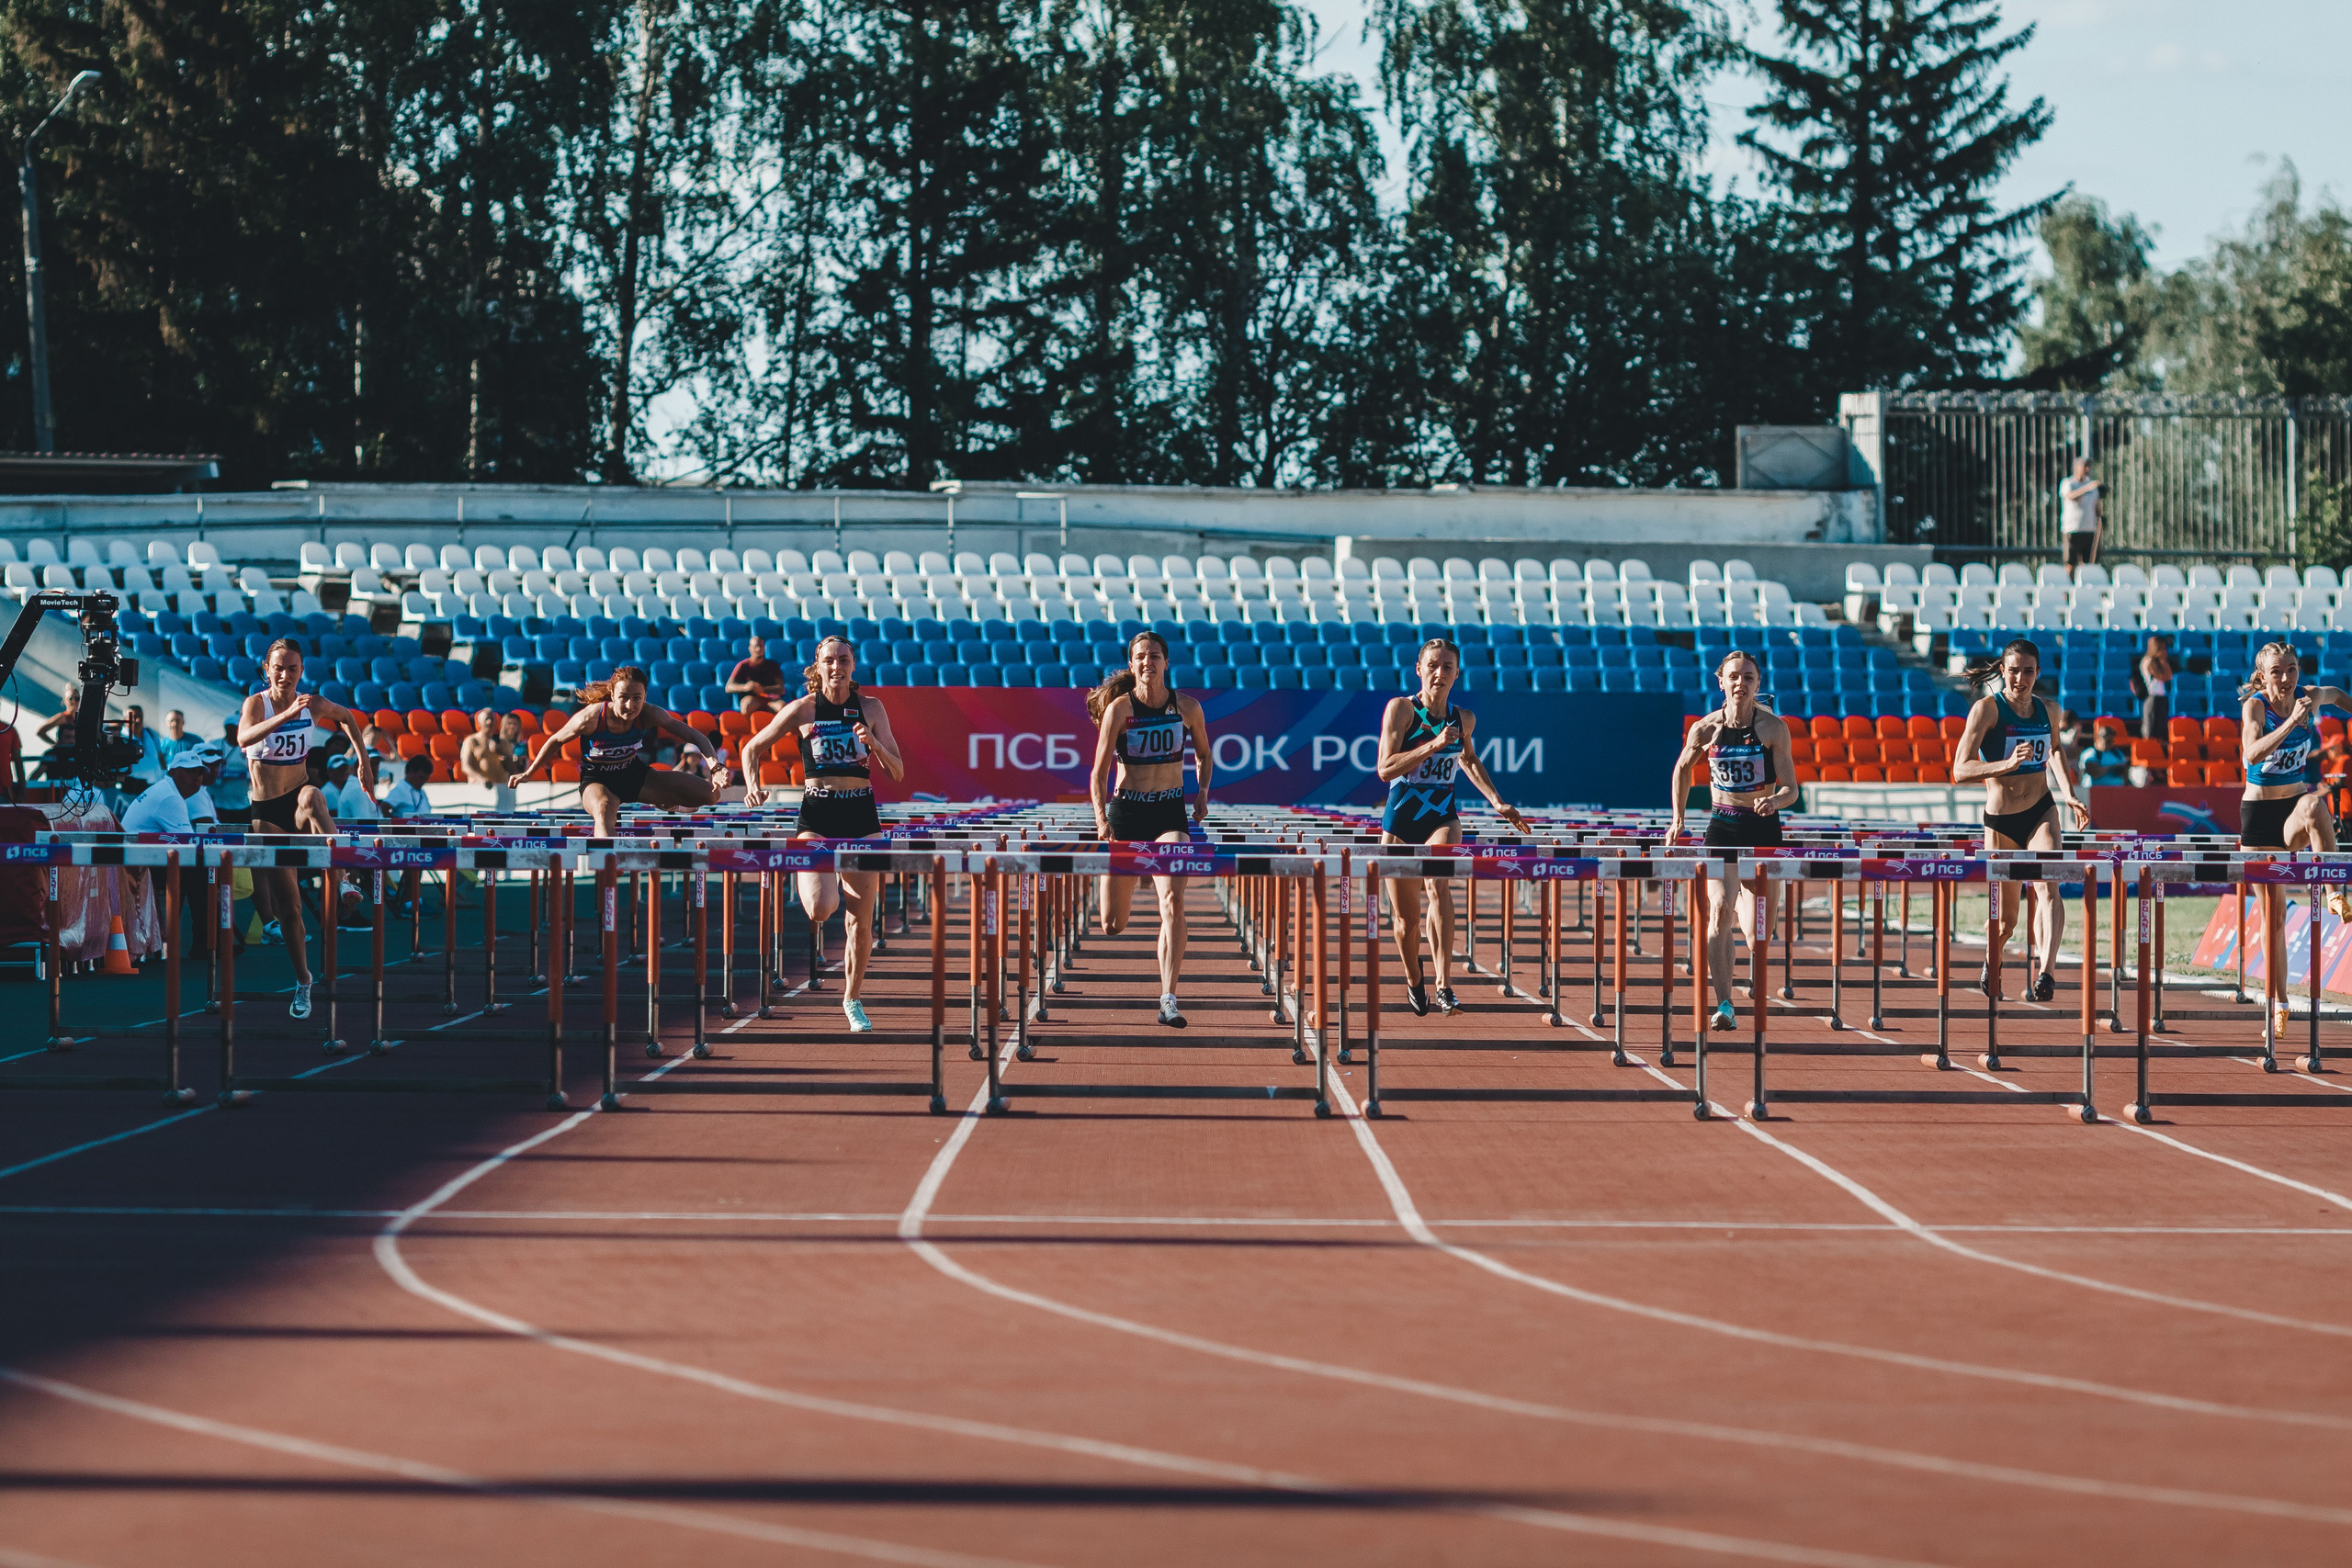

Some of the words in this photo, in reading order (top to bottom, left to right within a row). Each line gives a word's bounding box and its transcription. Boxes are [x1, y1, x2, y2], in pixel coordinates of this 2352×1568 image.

[274, 733, 305, 757] 251
[1136, 728, 1174, 753] 700
[820, 737, 857, 761] 354
[968, 732, 1080, 771] ПСБ
[1313, 735, 1544, 773] РОИИ
[600, 762, 628, 772] NIKE
[1419, 756, 1453, 781] 348
[1718, 760, 1755, 784] 353
[805, 784, 829, 797] PRO
[834, 787, 866, 799] NIKE
[1123, 789, 1157, 802] NIKE
[1159, 787, 1183, 801] PRO
[525, 840, 547, 849] ПСБ
[1172, 845, 1194, 854] ПСБ
[23, 848, 48, 858] ПСБ
[407, 852, 433, 863] ПСБ
[1496, 849, 1517, 857] ПСБ
[2141, 851, 2163, 860] ПСБ
[785, 855, 810, 865] ПСБ
[1186, 862, 1212, 872] ПСБ
[1549, 864, 1575, 875] ПСБ
[1938, 864, 1963, 874] ПСБ
[2321, 868, 2347, 878] ПСБ
